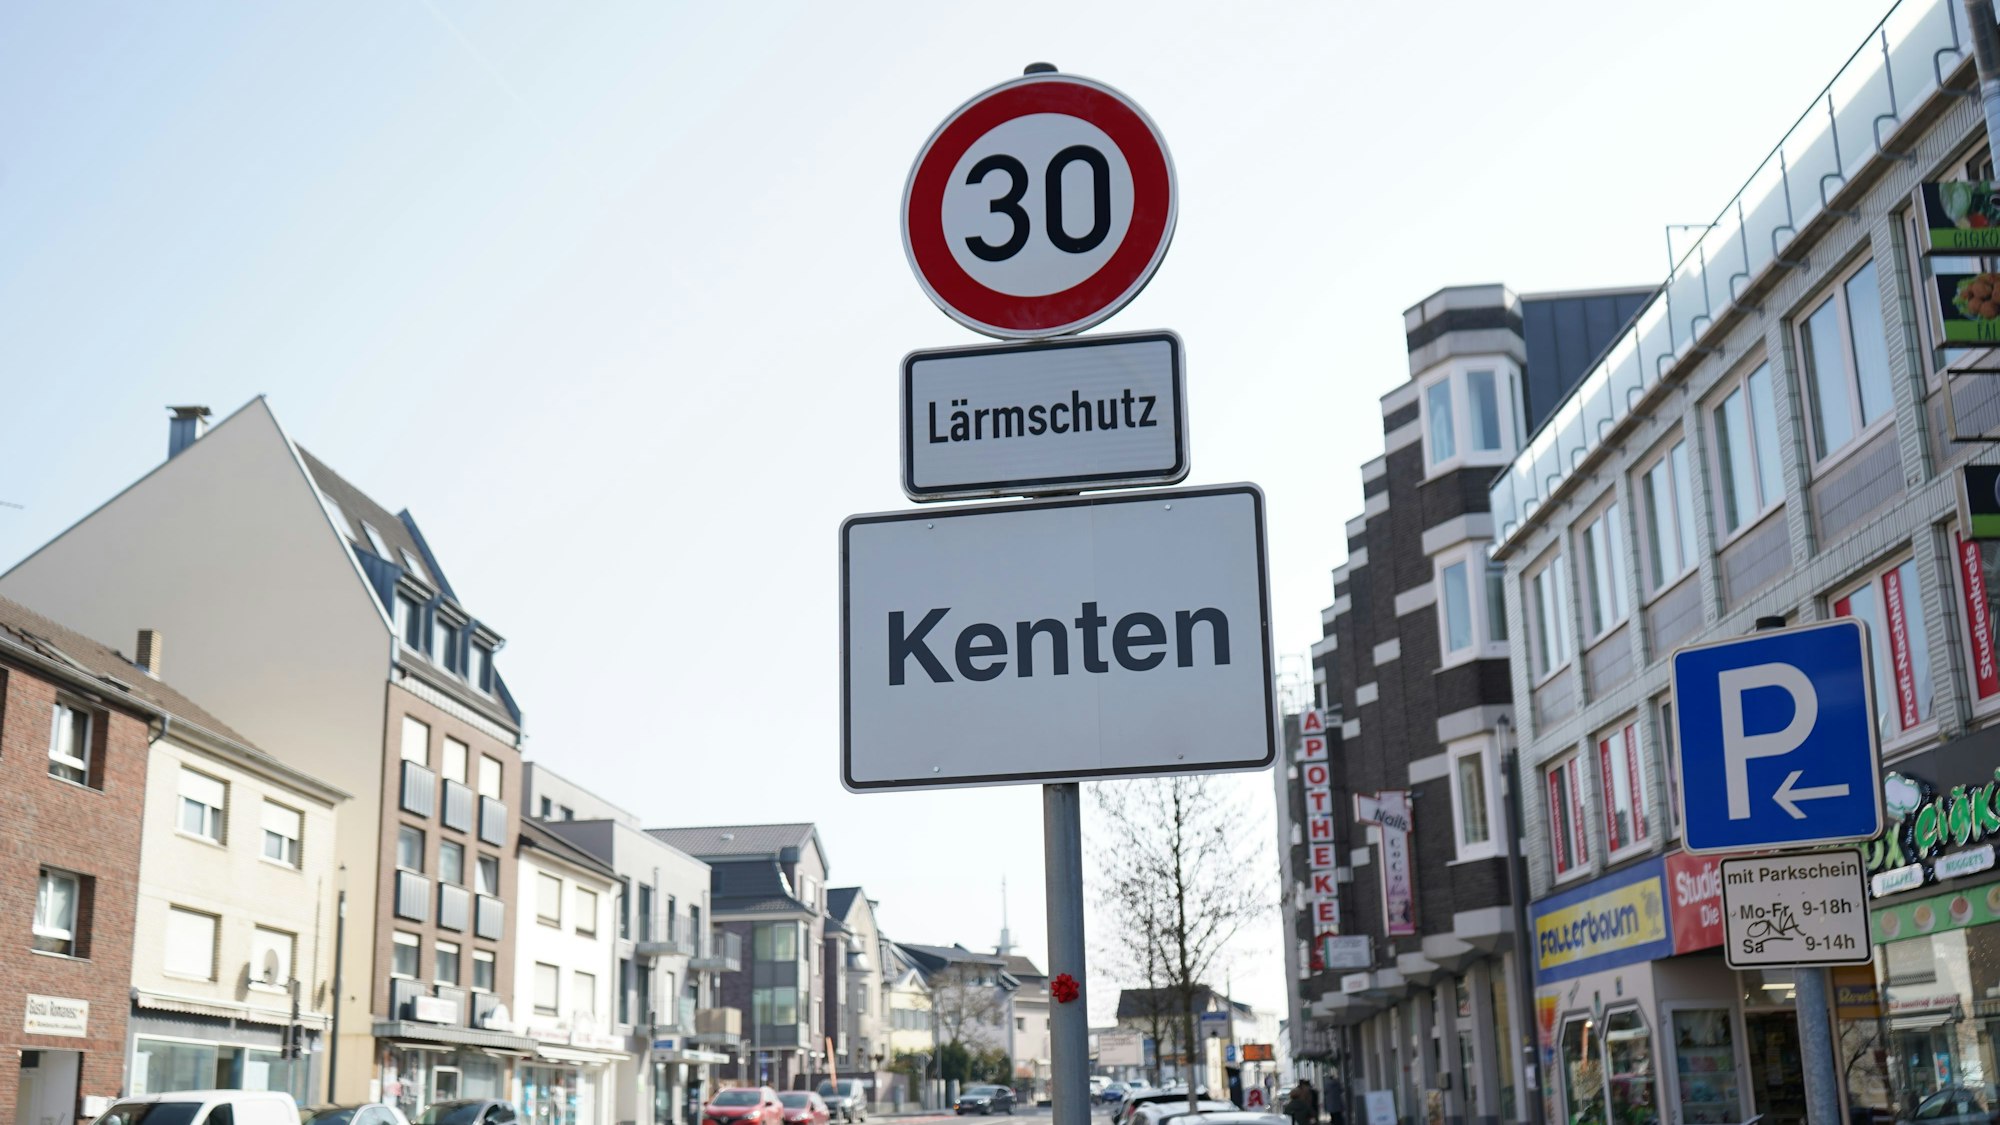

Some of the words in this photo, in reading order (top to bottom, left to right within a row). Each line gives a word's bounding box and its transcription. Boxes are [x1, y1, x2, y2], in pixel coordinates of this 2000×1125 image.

[965, 144, 1111, 262] 30
[929, 389, 1157, 443] Lärmschutz
[888, 601, 1231, 685] Kenten
[1966, 543, 1993, 680] Studienkreis
[1889, 574, 1915, 728] Profi-Nachhilfe
[1718, 661, 1818, 820] P
[1304, 711, 1334, 922] APOTHEKE
[1373, 808, 1408, 832] Nails
[1728, 870, 1754, 885] mit
[1759, 861, 1857, 883] Parkschein
[1701, 905, 1720, 928] Die
[1740, 902, 1789, 920] Mo-Fr
[1802, 898, 1851, 916] 9-18h
[1743, 939, 1764, 954] Sa
[1805, 934, 1855, 951] 9-14h
